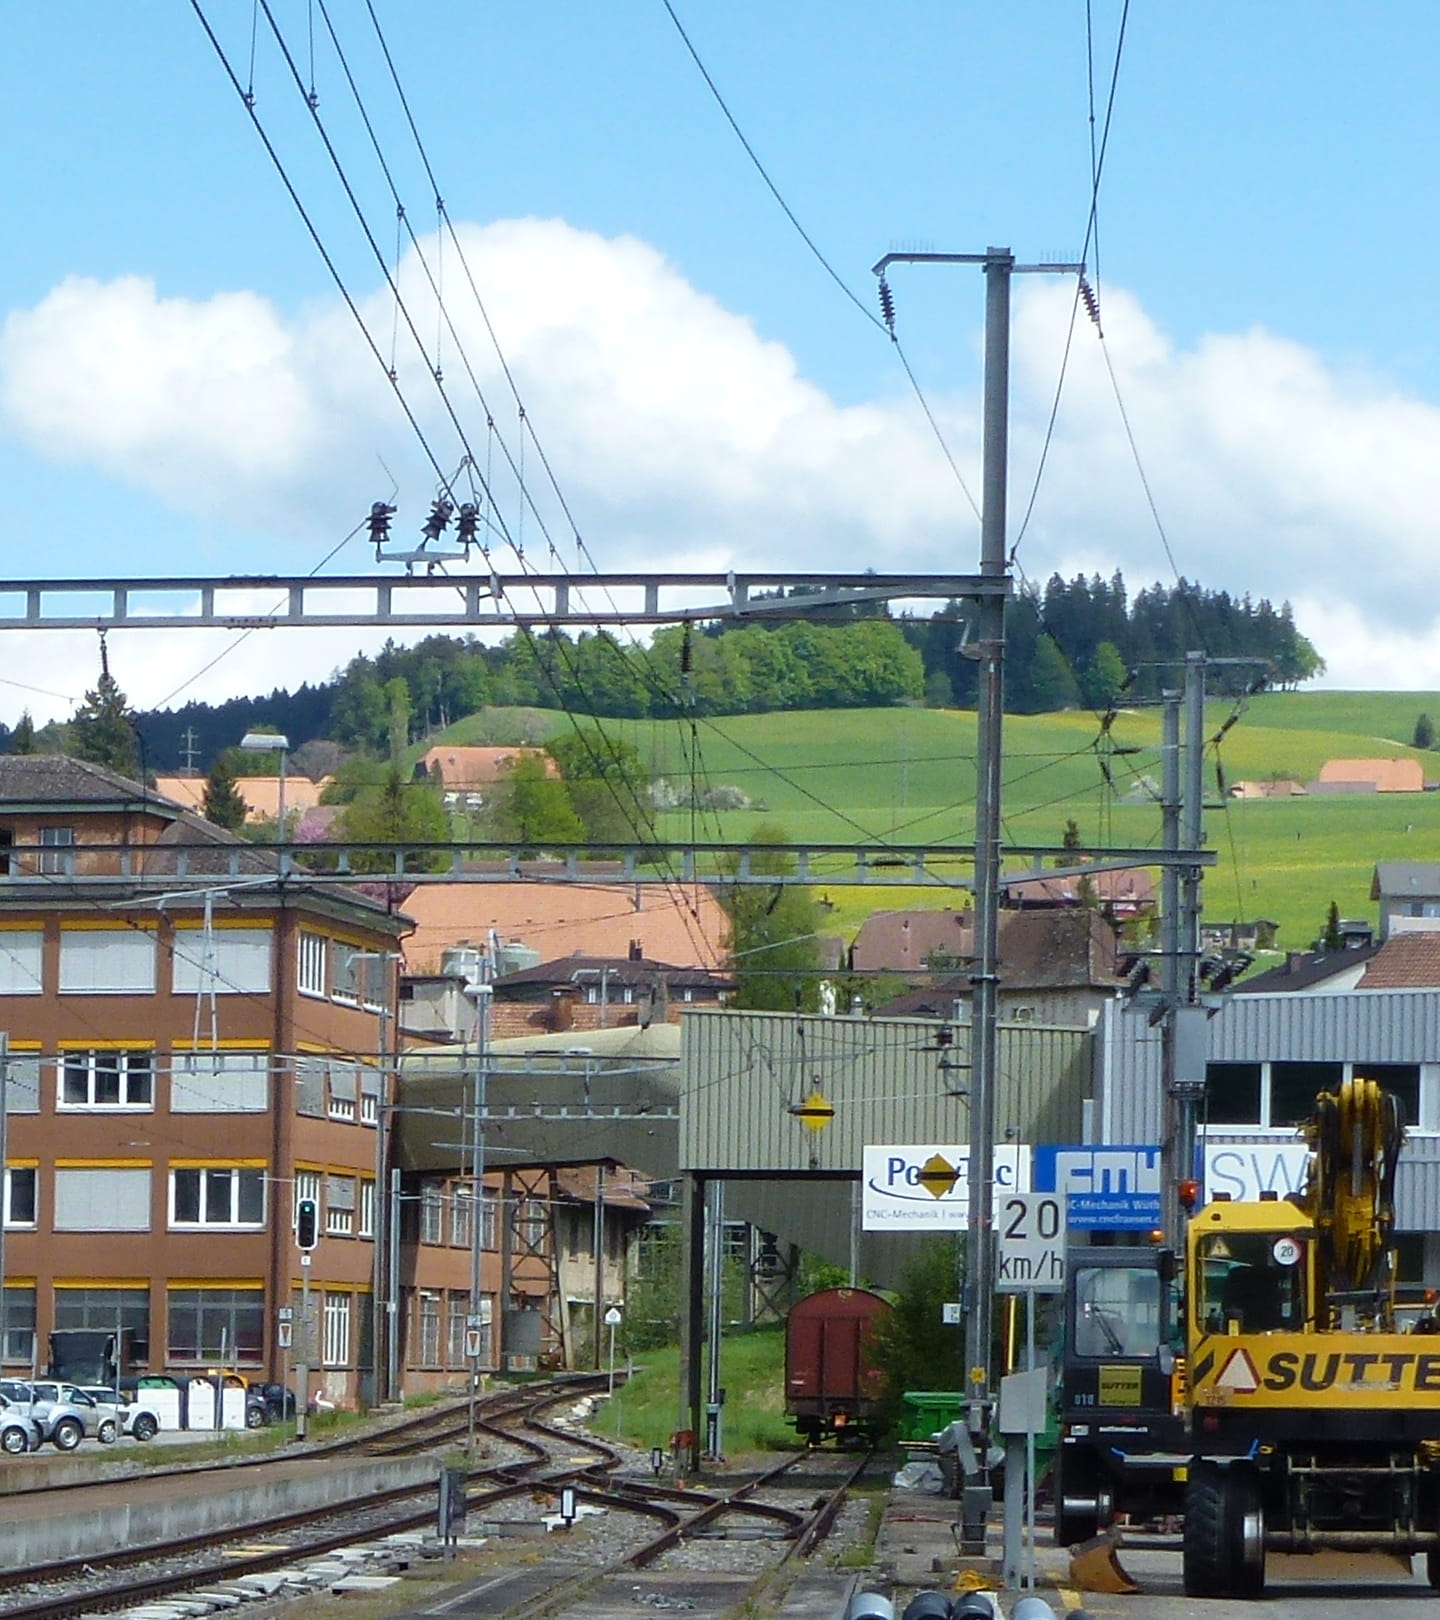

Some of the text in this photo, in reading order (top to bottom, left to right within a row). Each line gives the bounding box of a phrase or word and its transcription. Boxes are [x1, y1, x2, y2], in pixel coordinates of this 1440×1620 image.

[1005, 1200, 1059, 1239] 20
[999, 1251, 1064, 1280] km/h
[1280, 1246, 1294, 1257] 20
